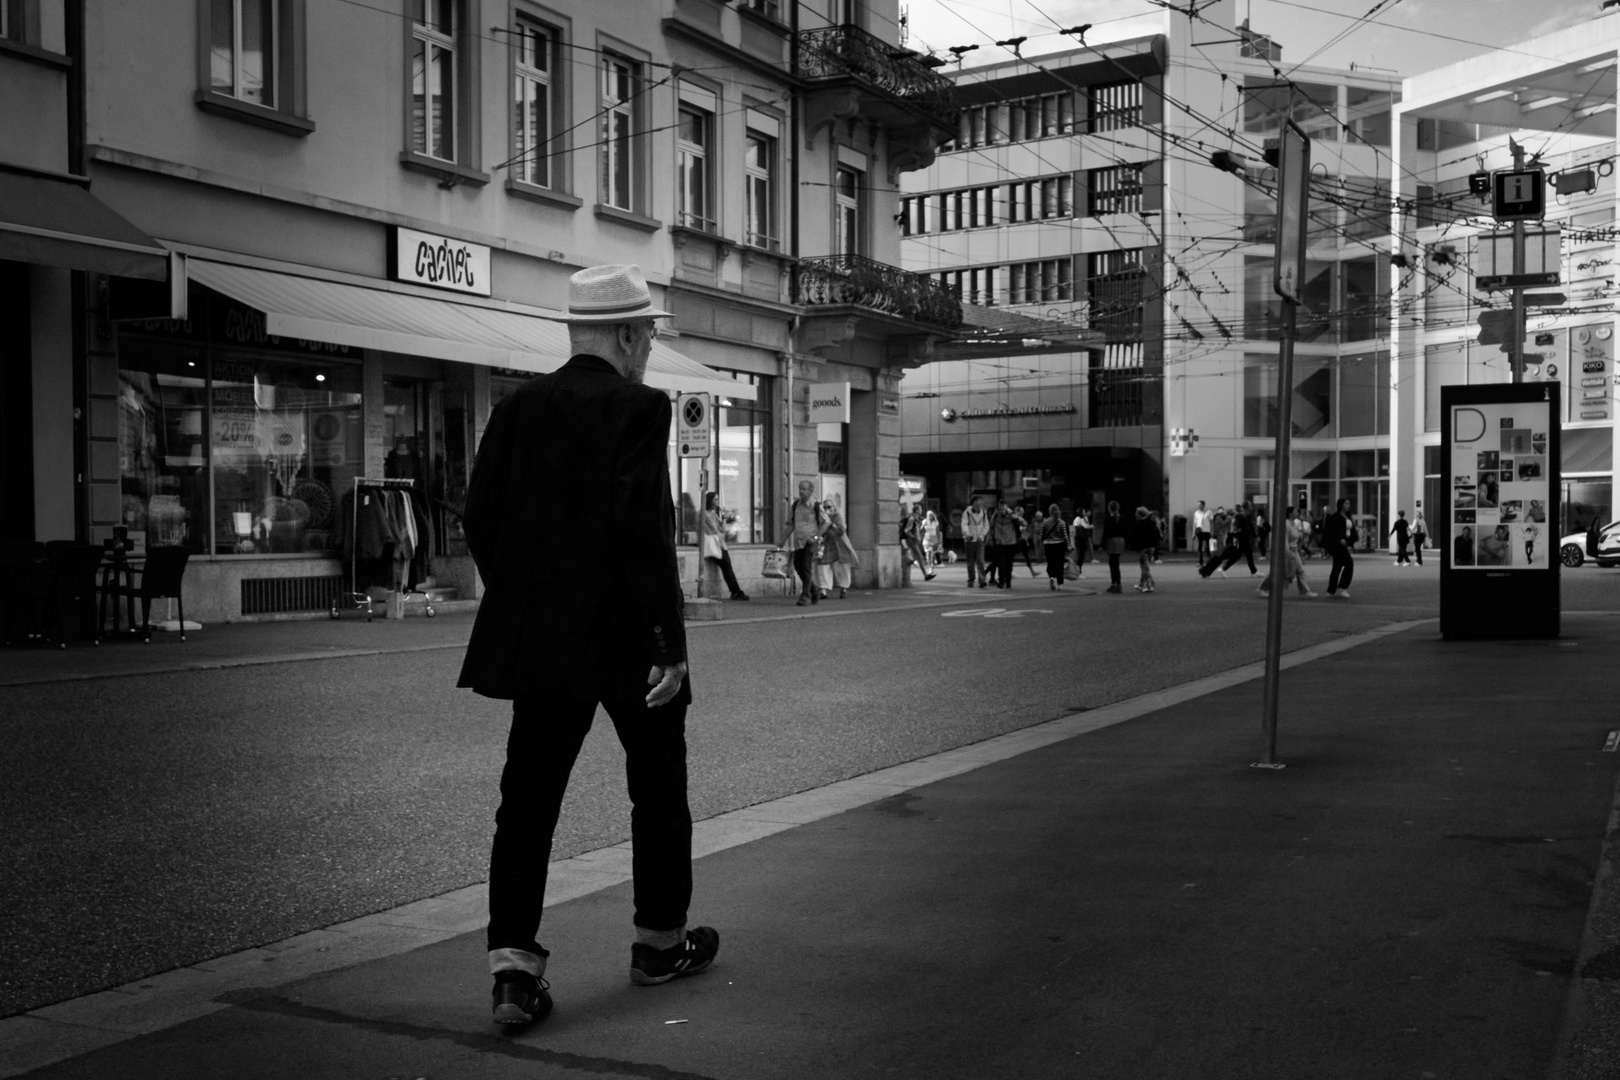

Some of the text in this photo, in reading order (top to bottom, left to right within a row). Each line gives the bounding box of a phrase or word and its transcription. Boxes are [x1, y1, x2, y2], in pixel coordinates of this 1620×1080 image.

[415, 239, 474, 287] cachet
[1583, 362, 1603, 370] KIKO
[215, 422, 256, 443] -20%
[1454, 408, 1487, 444] D
